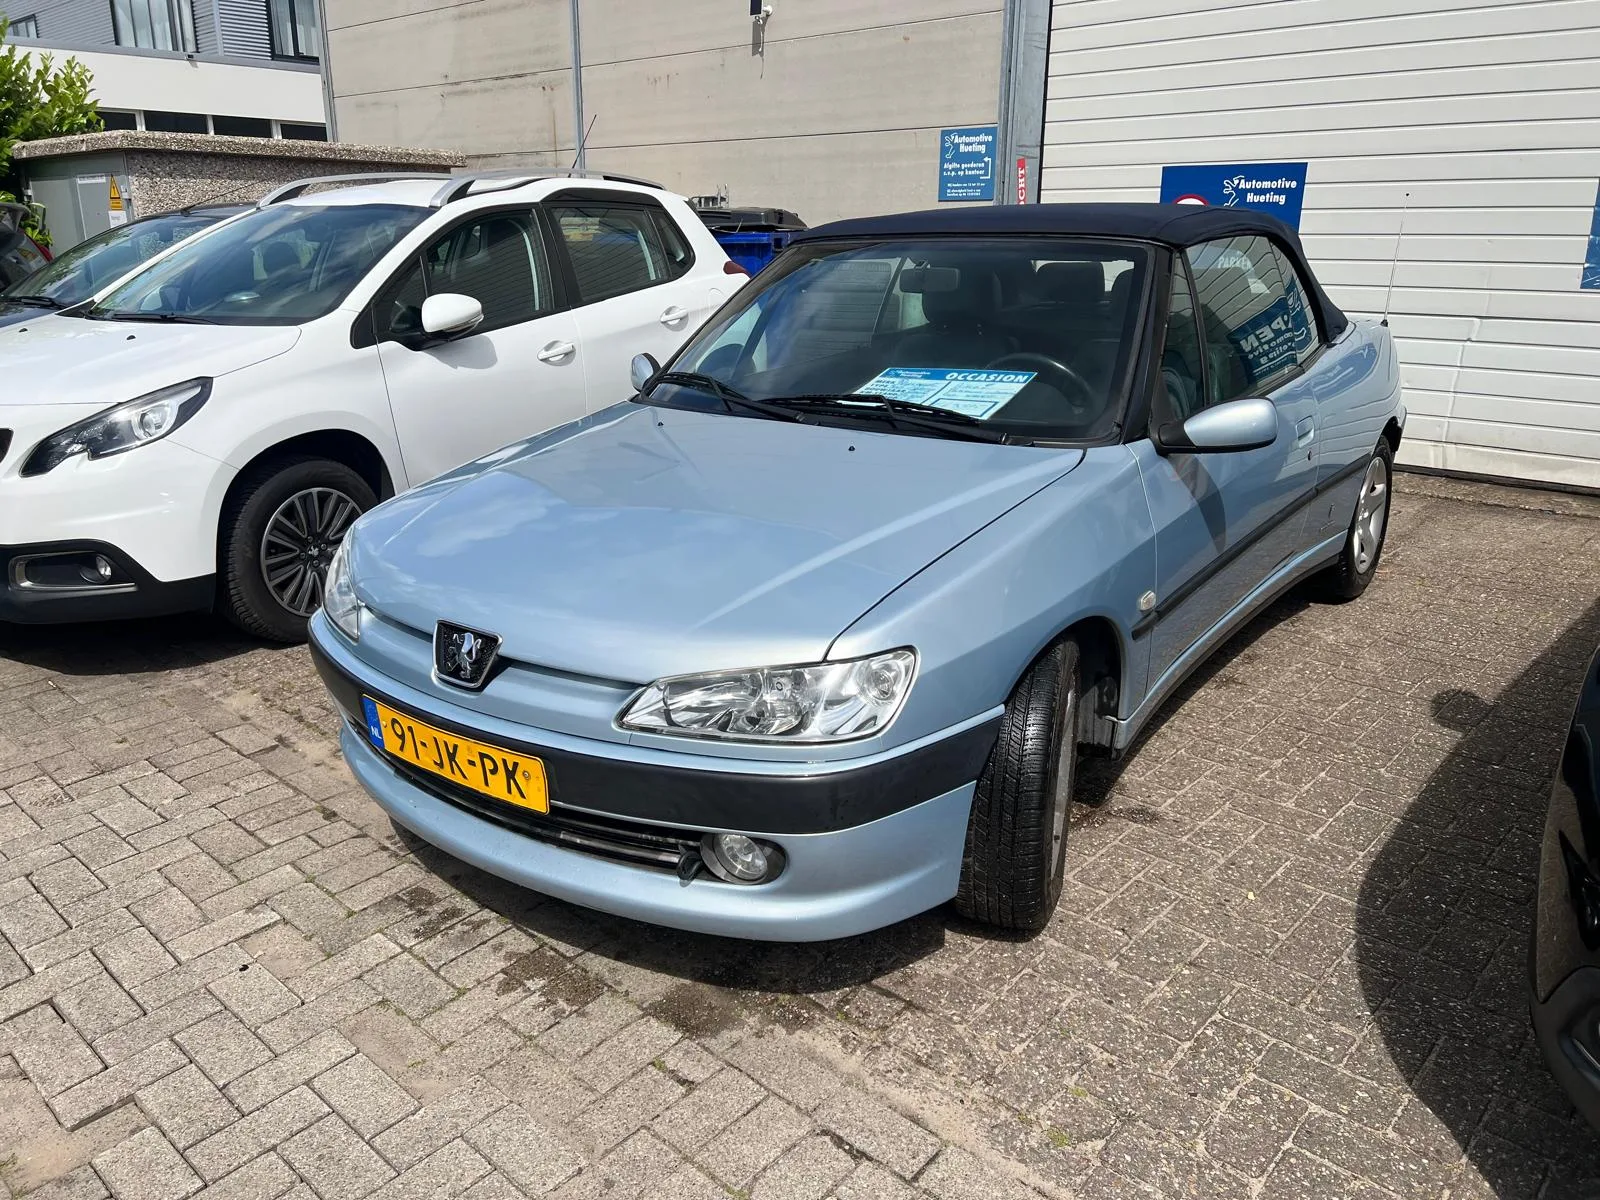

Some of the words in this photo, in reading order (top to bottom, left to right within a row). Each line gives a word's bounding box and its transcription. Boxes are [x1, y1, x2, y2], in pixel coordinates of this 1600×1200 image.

[953, 133, 993, 144] Automotive
[959, 143, 986, 154] Hueting
[1238, 177, 1297, 190] Automotive
[1246, 192, 1286, 205] Hueting
[945, 372, 1029, 383] OCCASION
[370, 725, 383, 740] NL
[390, 717, 527, 800] 91-JK-PK
